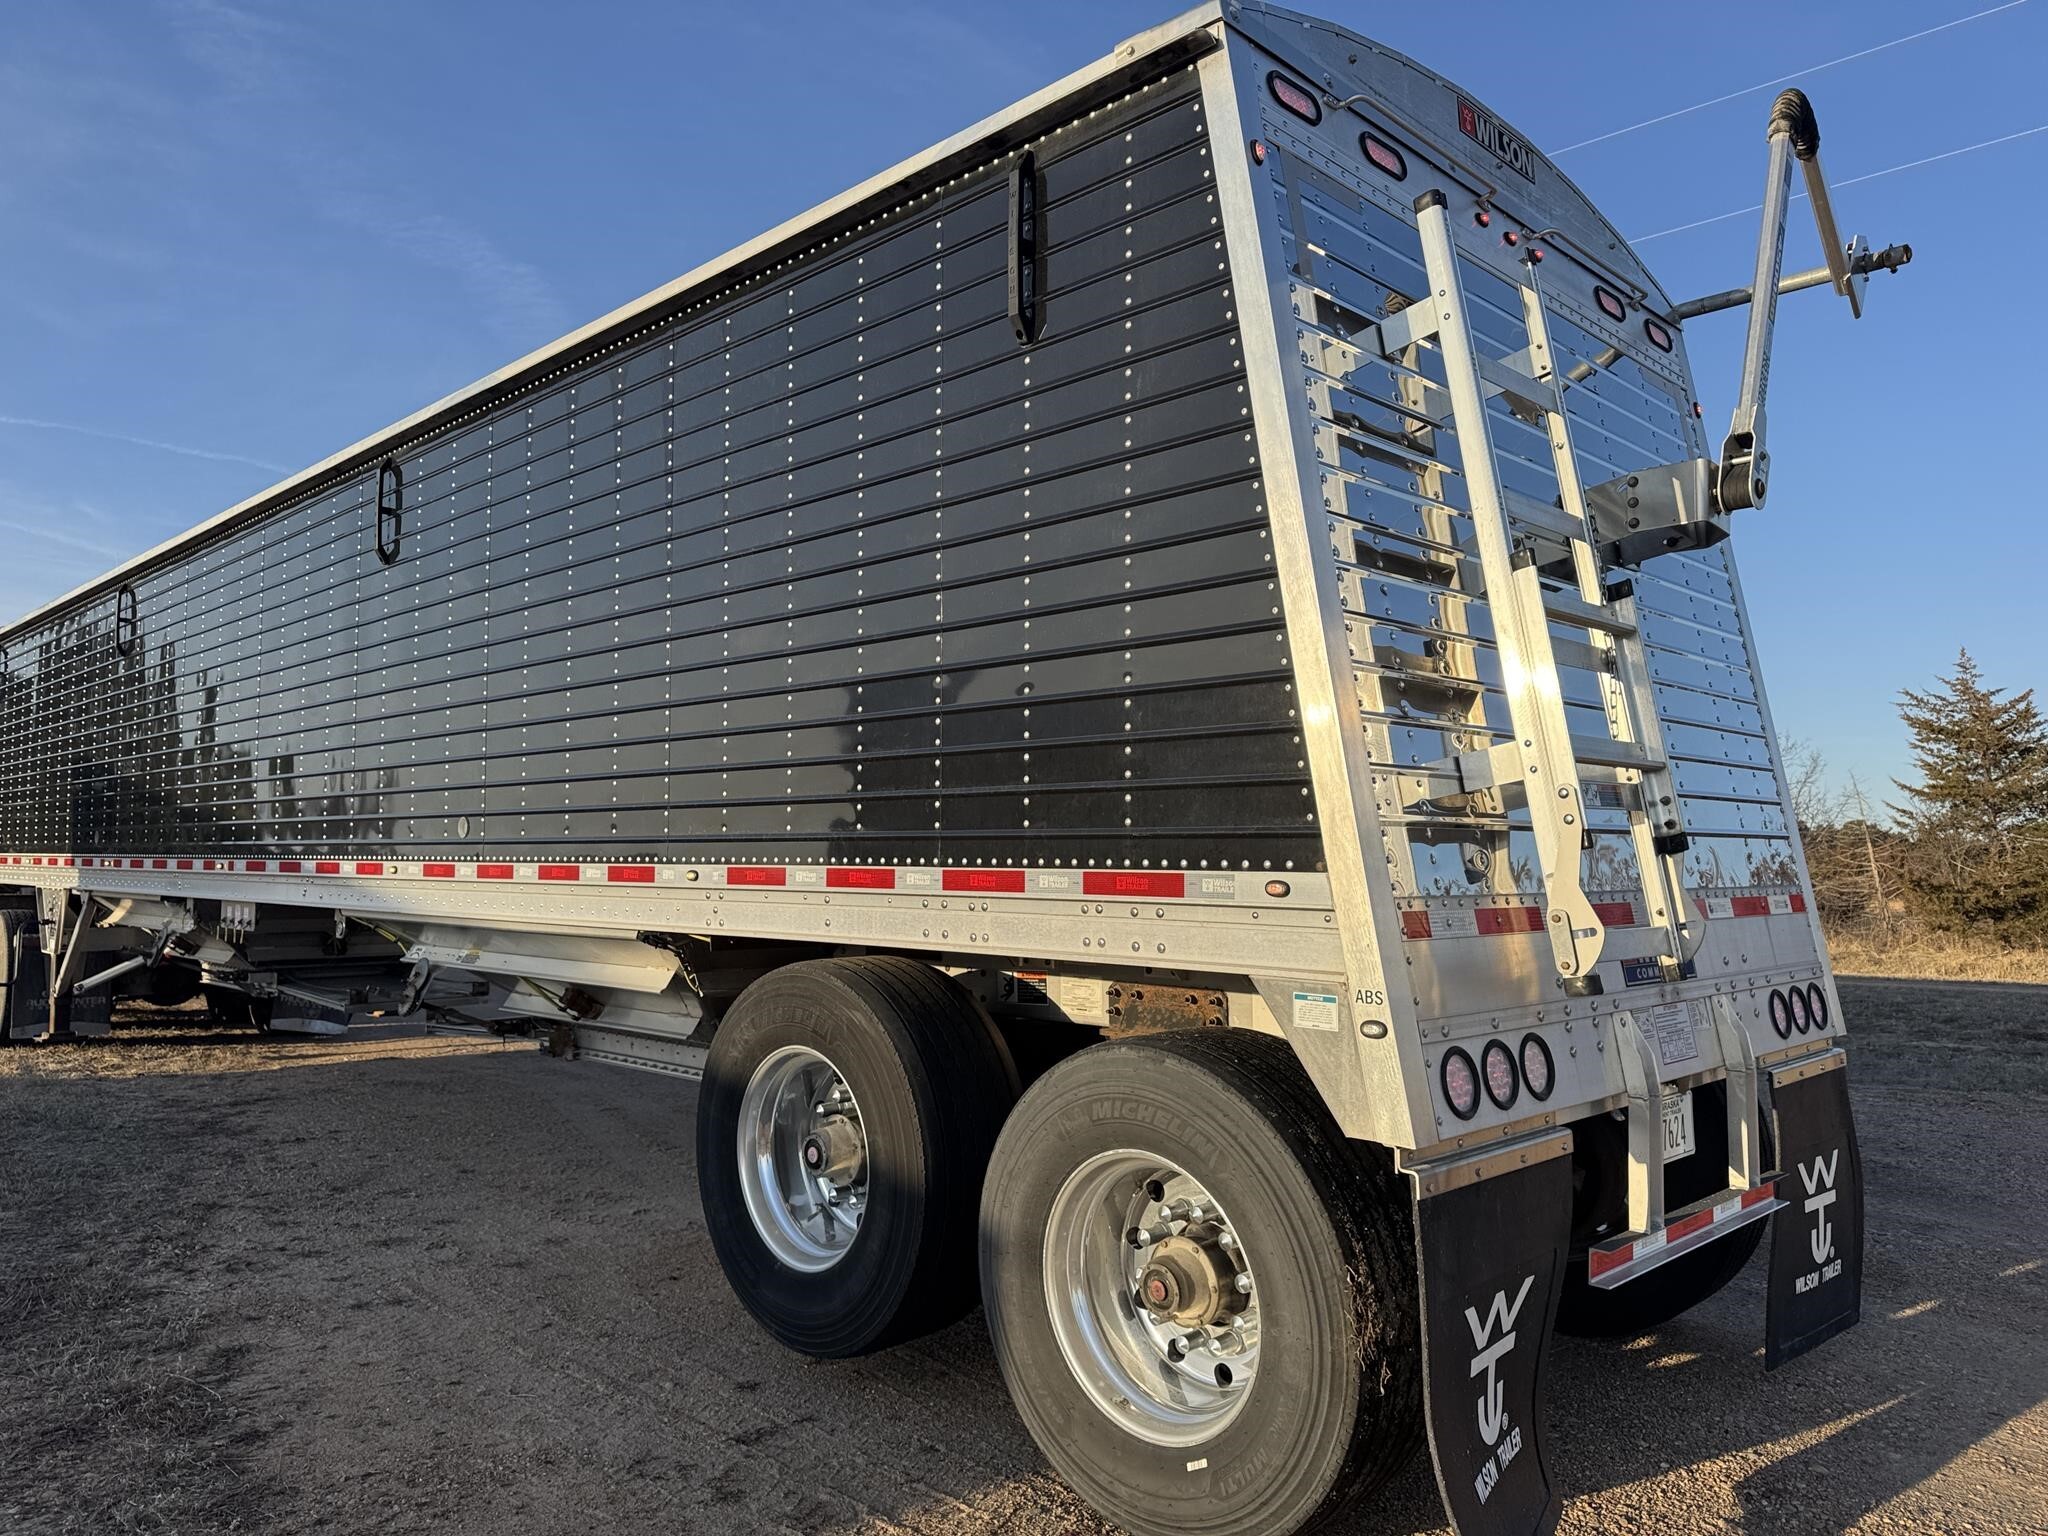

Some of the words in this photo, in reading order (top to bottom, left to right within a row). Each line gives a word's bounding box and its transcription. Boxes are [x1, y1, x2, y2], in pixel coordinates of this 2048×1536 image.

[1473, 112, 1535, 178] WILSON
[1355, 989, 1384, 1006] ABS
[1092, 1099, 1217, 1157] MICHELIN
[1662, 1114, 1686, 1151] 7624
[1795, 1270, 1820, 1295] WILSON
[1822, 1259, 1842, 1283] TRAILER
[1474, 1456, 1499, 1505] WILSON
[1497, 1426, 1522, 1471] TRAILER
